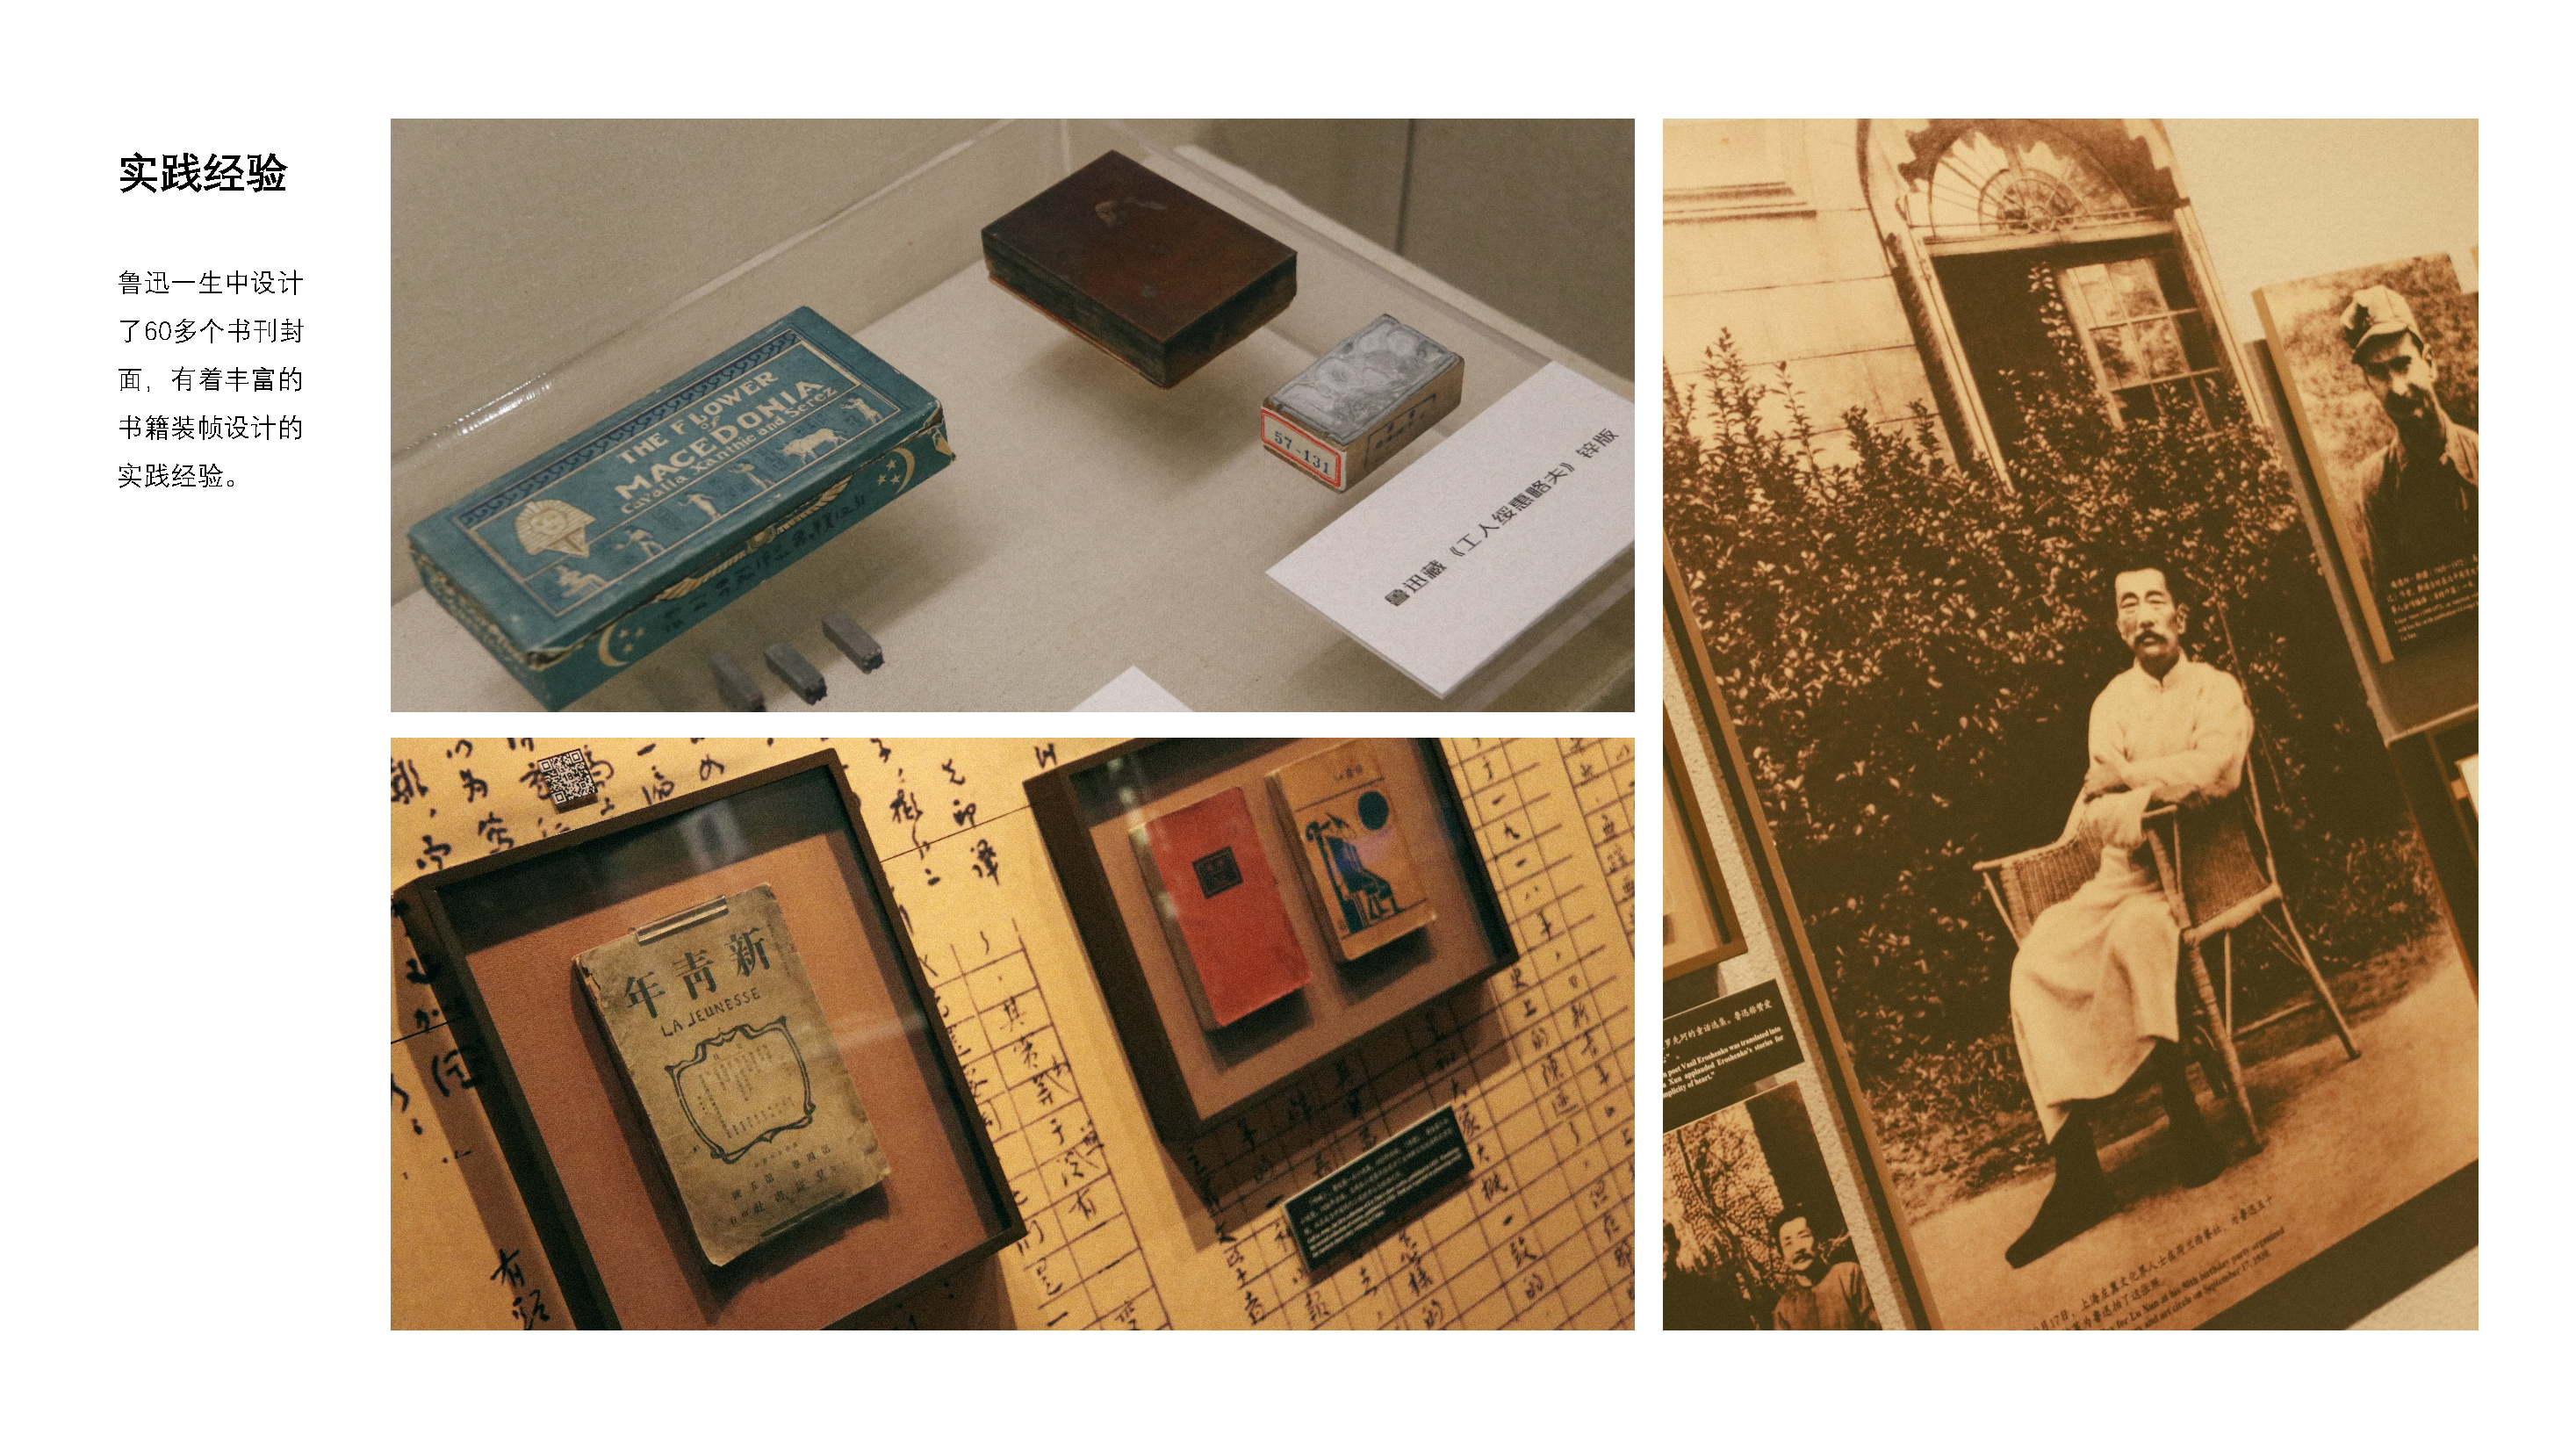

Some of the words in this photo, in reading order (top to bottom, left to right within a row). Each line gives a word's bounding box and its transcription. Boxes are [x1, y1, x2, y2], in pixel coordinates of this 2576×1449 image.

[616, 432, 669, 465] THE
[669, 371, 779, 436] FLOWER
[701, 415, 721, 431] of
[758, 416, 786, 436] and
[784, 386, 838, 419] Serez
[615, 380, 825, 501] MACEDONIA
[1274, 429, 1331, 477] 57-131
[660, 1019, 684, 1037] LA
[687, 986, 761, 1028] JEUNESSE
[1667, 1065, 1682, 1078] poet
[1696, 1047, 1729, 1064] Eroshenko
[1728, 1042, 1741, 1051] was
[1740, 1029, 1770, 1047] translated
[1768, 1026, 1781, 1035] into
[1668, 1076, 1682, 1085] Xun
[1684, 1061, 1716, 1080] applauded
[1753, 1039, 1774, 1051] stories
[1774, 1034, 1784, 1043] for
[1687, 1079, 1695, 1089] of
[2116, 1318, 2128, 1329] for
[2129, 1310, 2142, 1322] Lu
[2161, 1294, 2169, 1304] at
[2169, 1287, 2182, 1298] his
[2198, 1258, 2230, 1280] birthday
[2230, 1248, 2249, 1265] party
[2251, 1225, 2285, 1251] organized
[2144, 1314, 2160, 1329] and
[2160, 1308, 2172, 1320] art
[2171, 1295, 2192, 1313] circle
[2193, 1290, 2203, 1300] on
[2202, 1267, 2241, 1295] September
